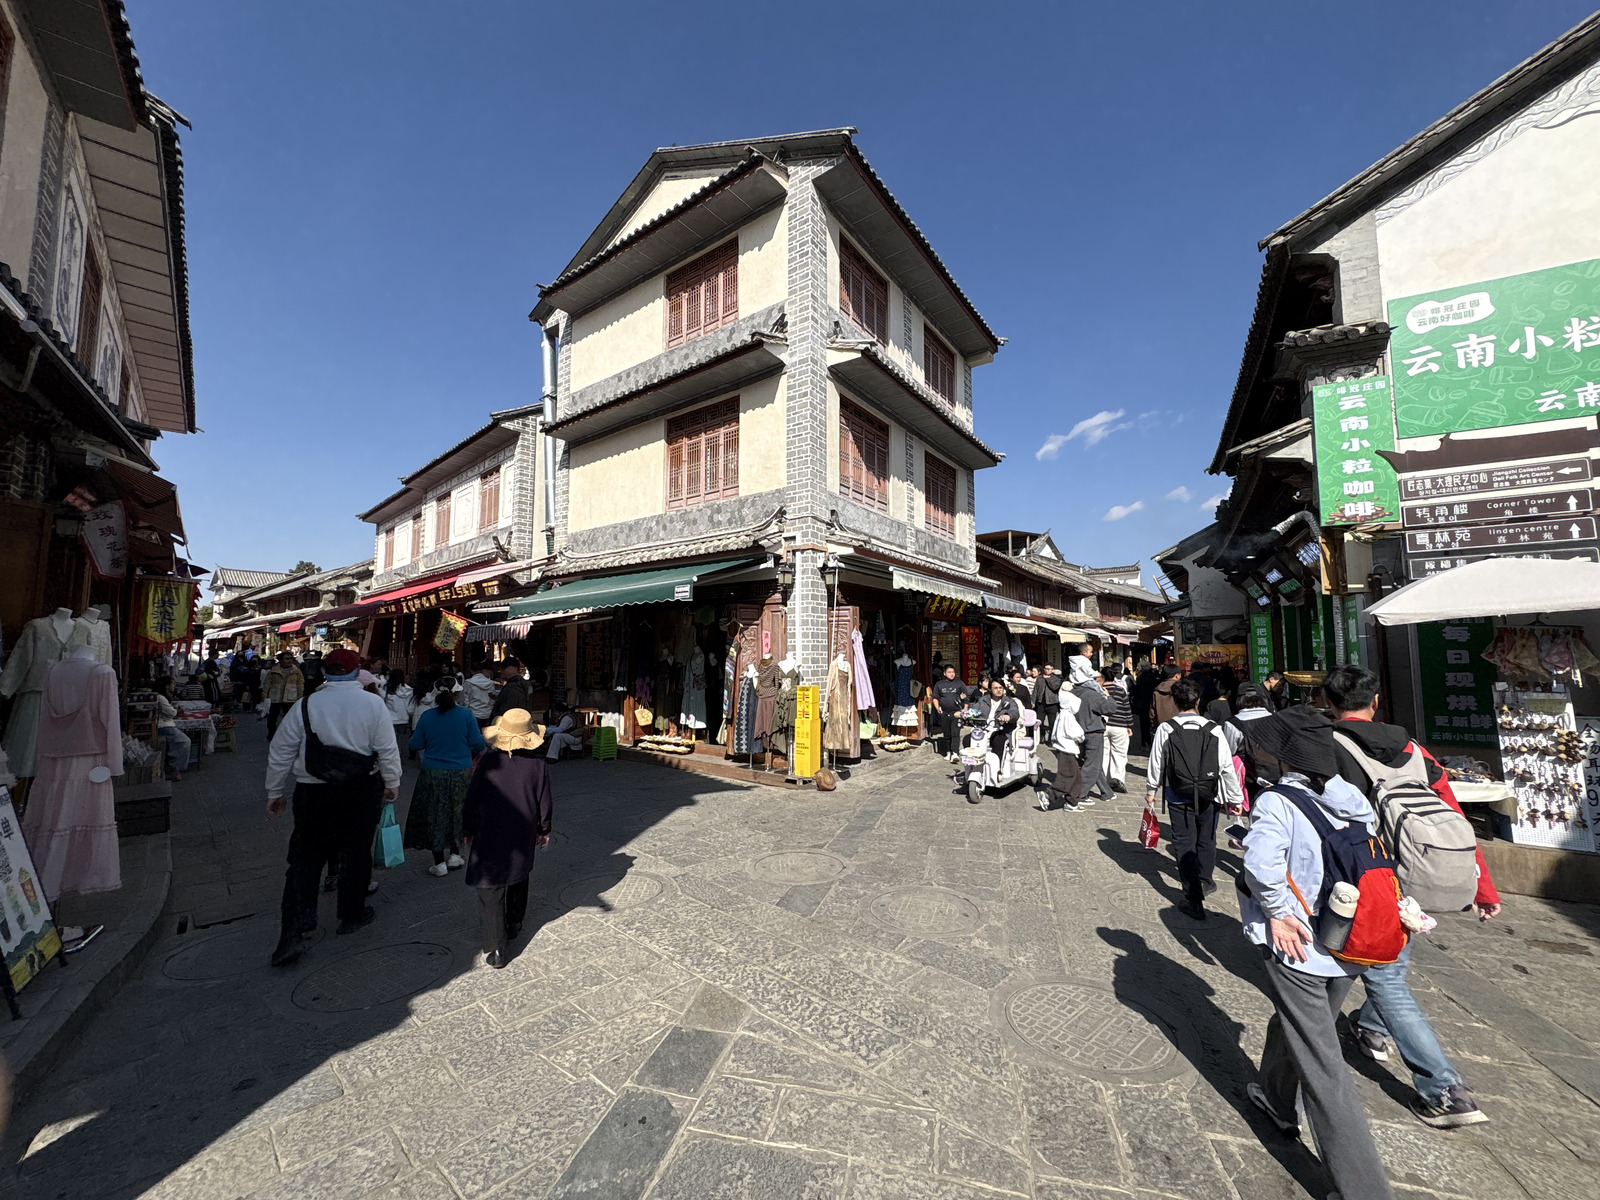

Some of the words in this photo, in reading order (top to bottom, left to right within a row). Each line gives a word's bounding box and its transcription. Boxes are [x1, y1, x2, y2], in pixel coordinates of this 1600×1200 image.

[1416, 310, 1476, 328] 云南好咖啡
[1402, 315, 1600, 377] 云南小粒
[1534, 381, 1600, 413] 云南
[1338, 394, 1377, 518] 云南小粒咖啡
[1506, 473, 1518, 481] Folk
[1531, 470, 1554, 478] Center
[1518, 465, 1551, 474] Collection
[1415, 503, 1469, 519] 转角楼
[1486, 499, 1521, 510] Corner
[1524, 496, 1557, 506] Tower
[1415, 529, 1471, 545] 喜林苑
[1488, 526, 1522, 536] linden
[1523, 523, 1560, 534] centre
[91, 509, 125, 569] 玫瑰花茶
[1441, 625, 1478, 711] 每日现烘
[1434, 713, 1493, 729] 更新鲜
